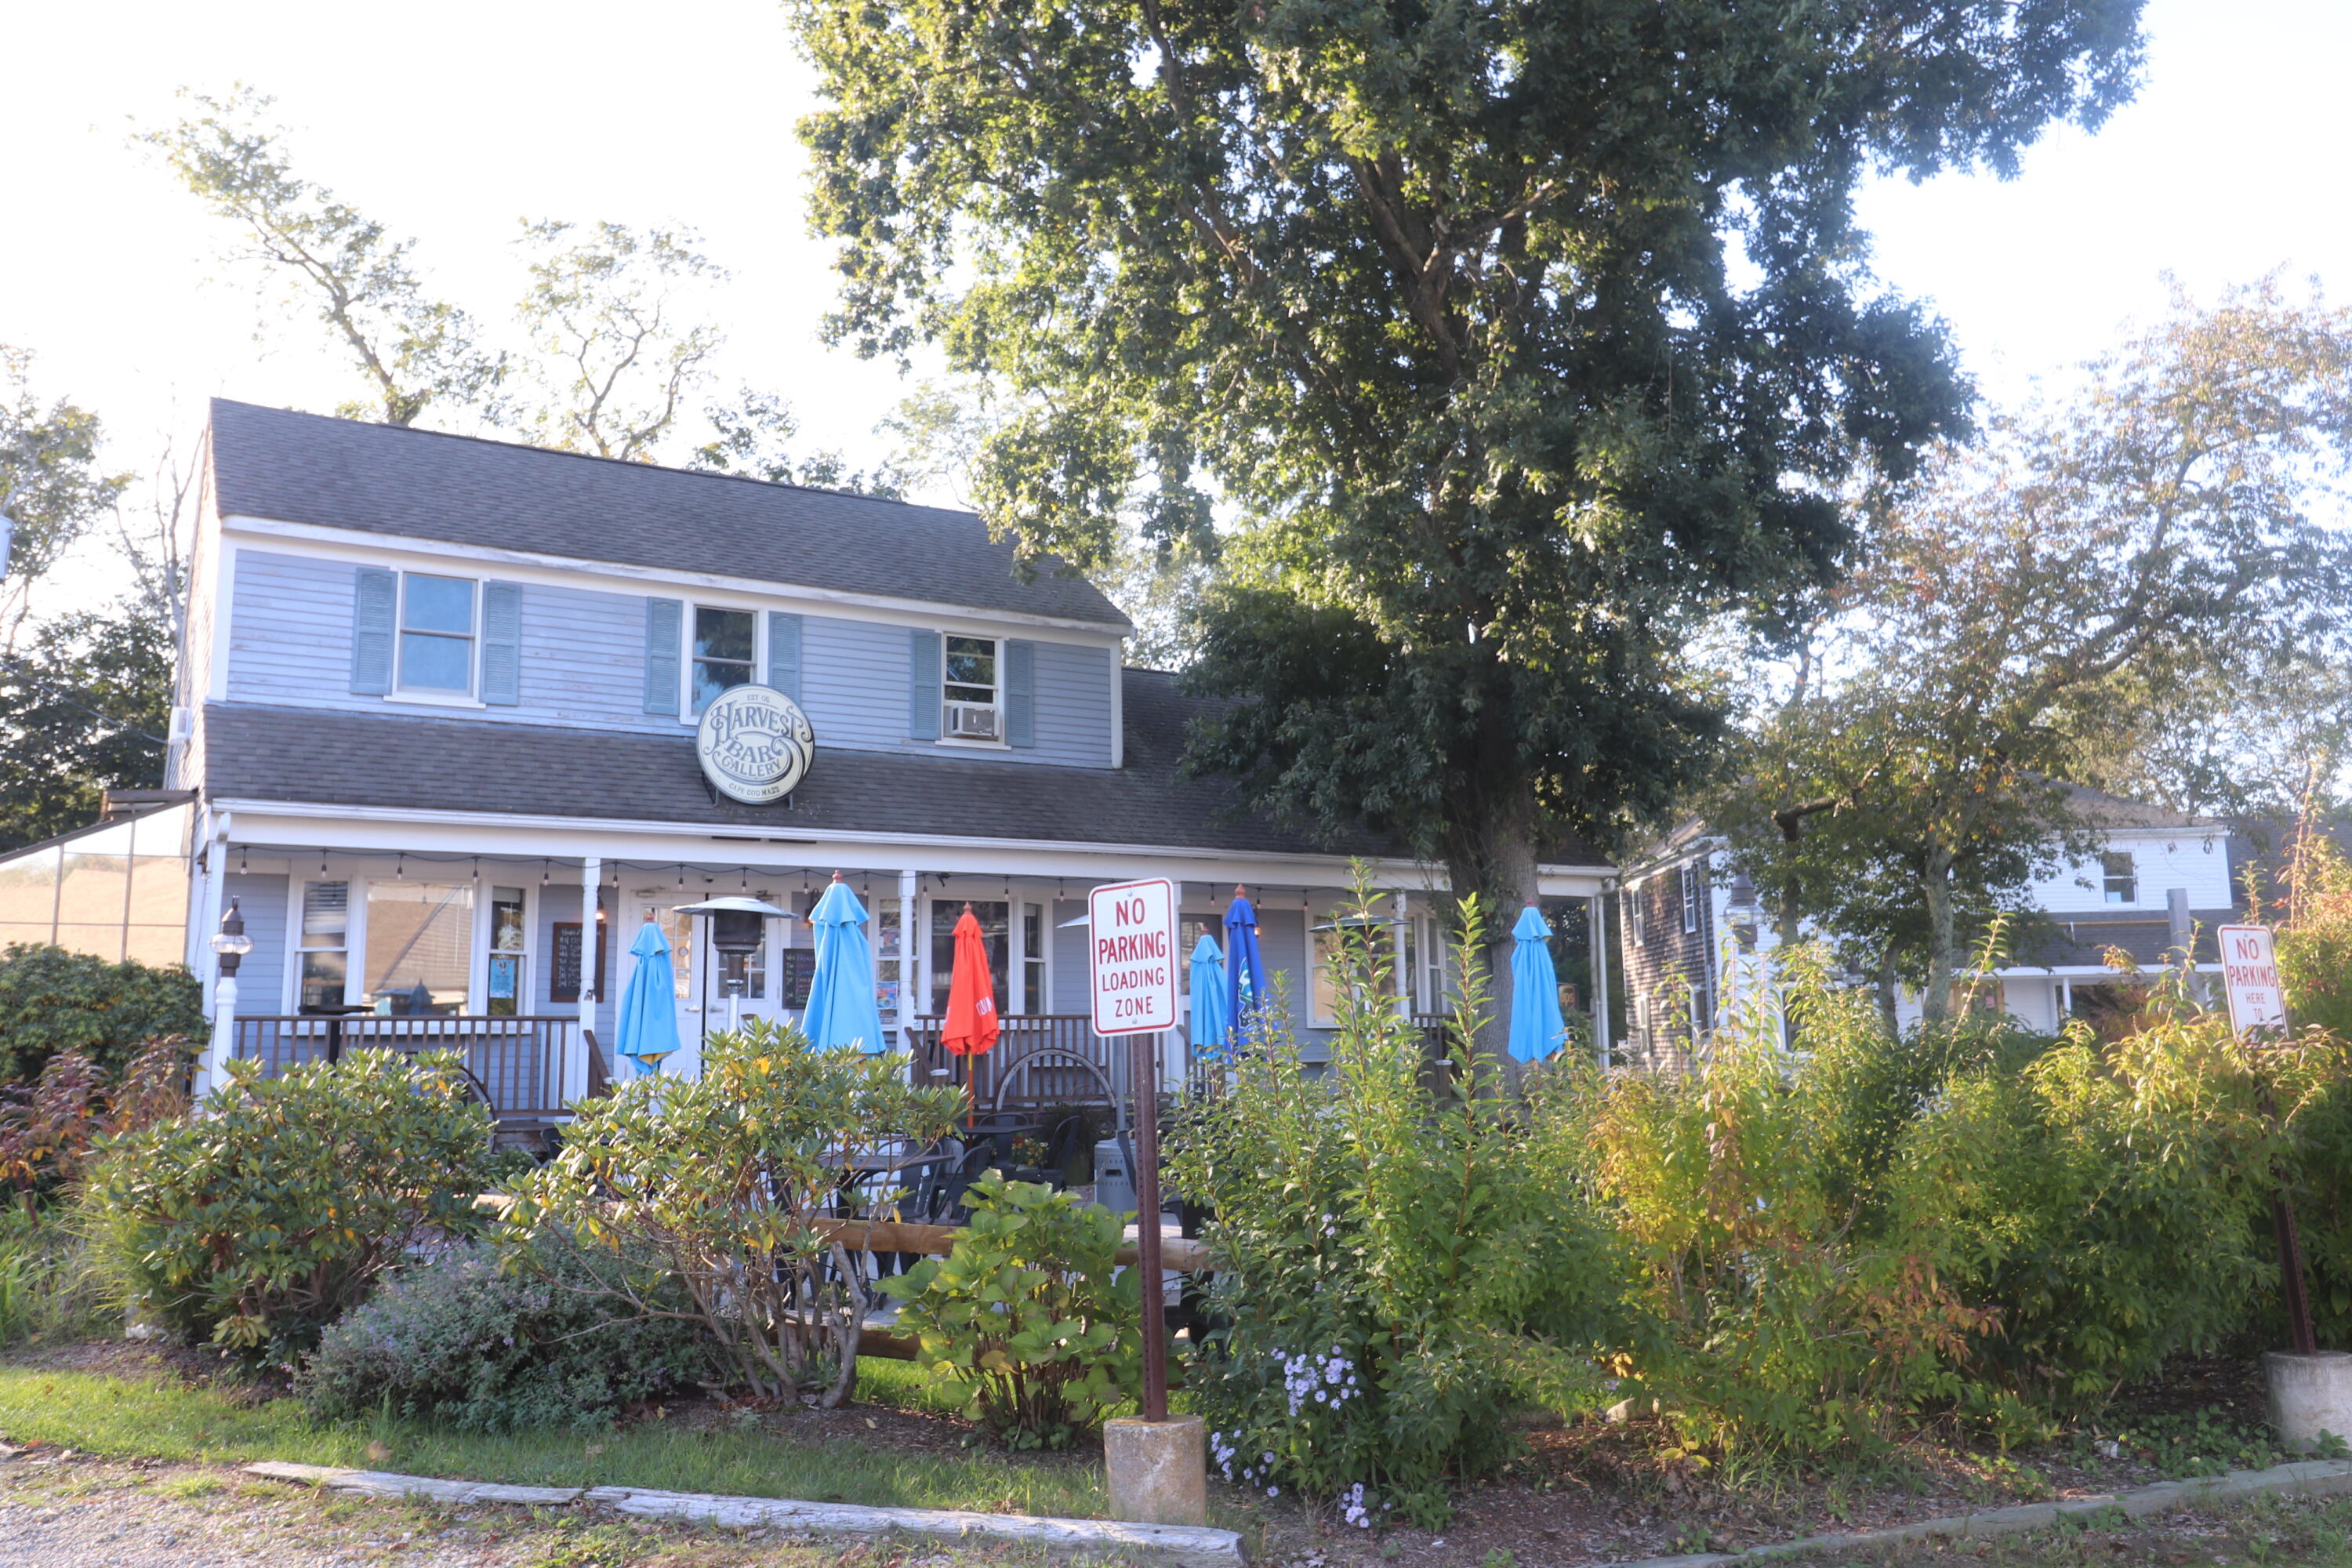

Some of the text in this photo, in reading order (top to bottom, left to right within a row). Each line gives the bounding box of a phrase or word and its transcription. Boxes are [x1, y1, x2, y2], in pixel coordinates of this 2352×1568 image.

[705, 700, 803, 750] HARVEST
[724, 737, 784, 764] BAR
[721, 755, 781, 777] GALLERY
[728, 782, 746, 795] CAPE
[761, 786, 780, 797] MASS
[1116, 898, 1145, 927] NO
[1098, 931, 1166, 964] PARKING
[2236, 938, 2259, 960] NO
[1102, 967, 1164, 992] LOADING
[2229, 965, 2277, 987] PARKING
[1115, 996, 1153, 1018] ZONE
[2245, 993, 2266, 1004] HERE
[2253, 1007, 2263, 1020] TO
